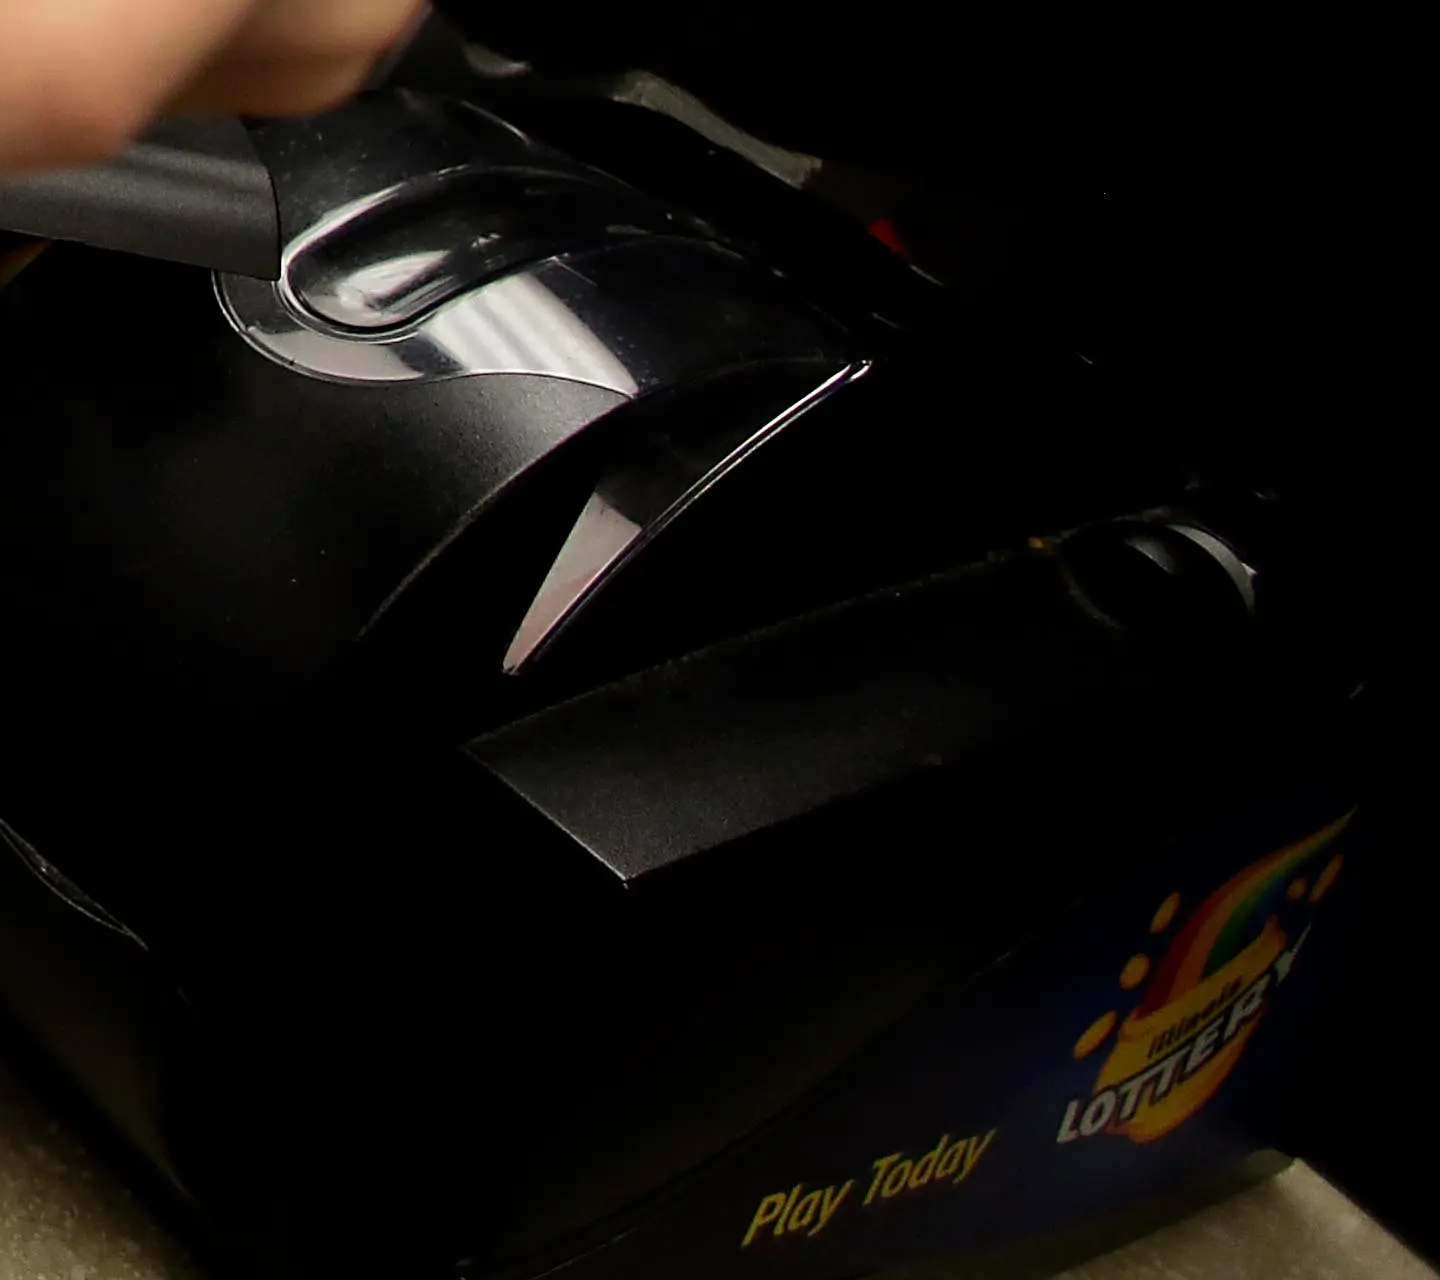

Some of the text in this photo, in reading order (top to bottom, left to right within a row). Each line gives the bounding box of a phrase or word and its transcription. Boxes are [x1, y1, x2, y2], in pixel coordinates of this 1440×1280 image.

[1056, 921, 1314, 1143] LOTTERY
[742, 1127, 999, 1250] Play Today
